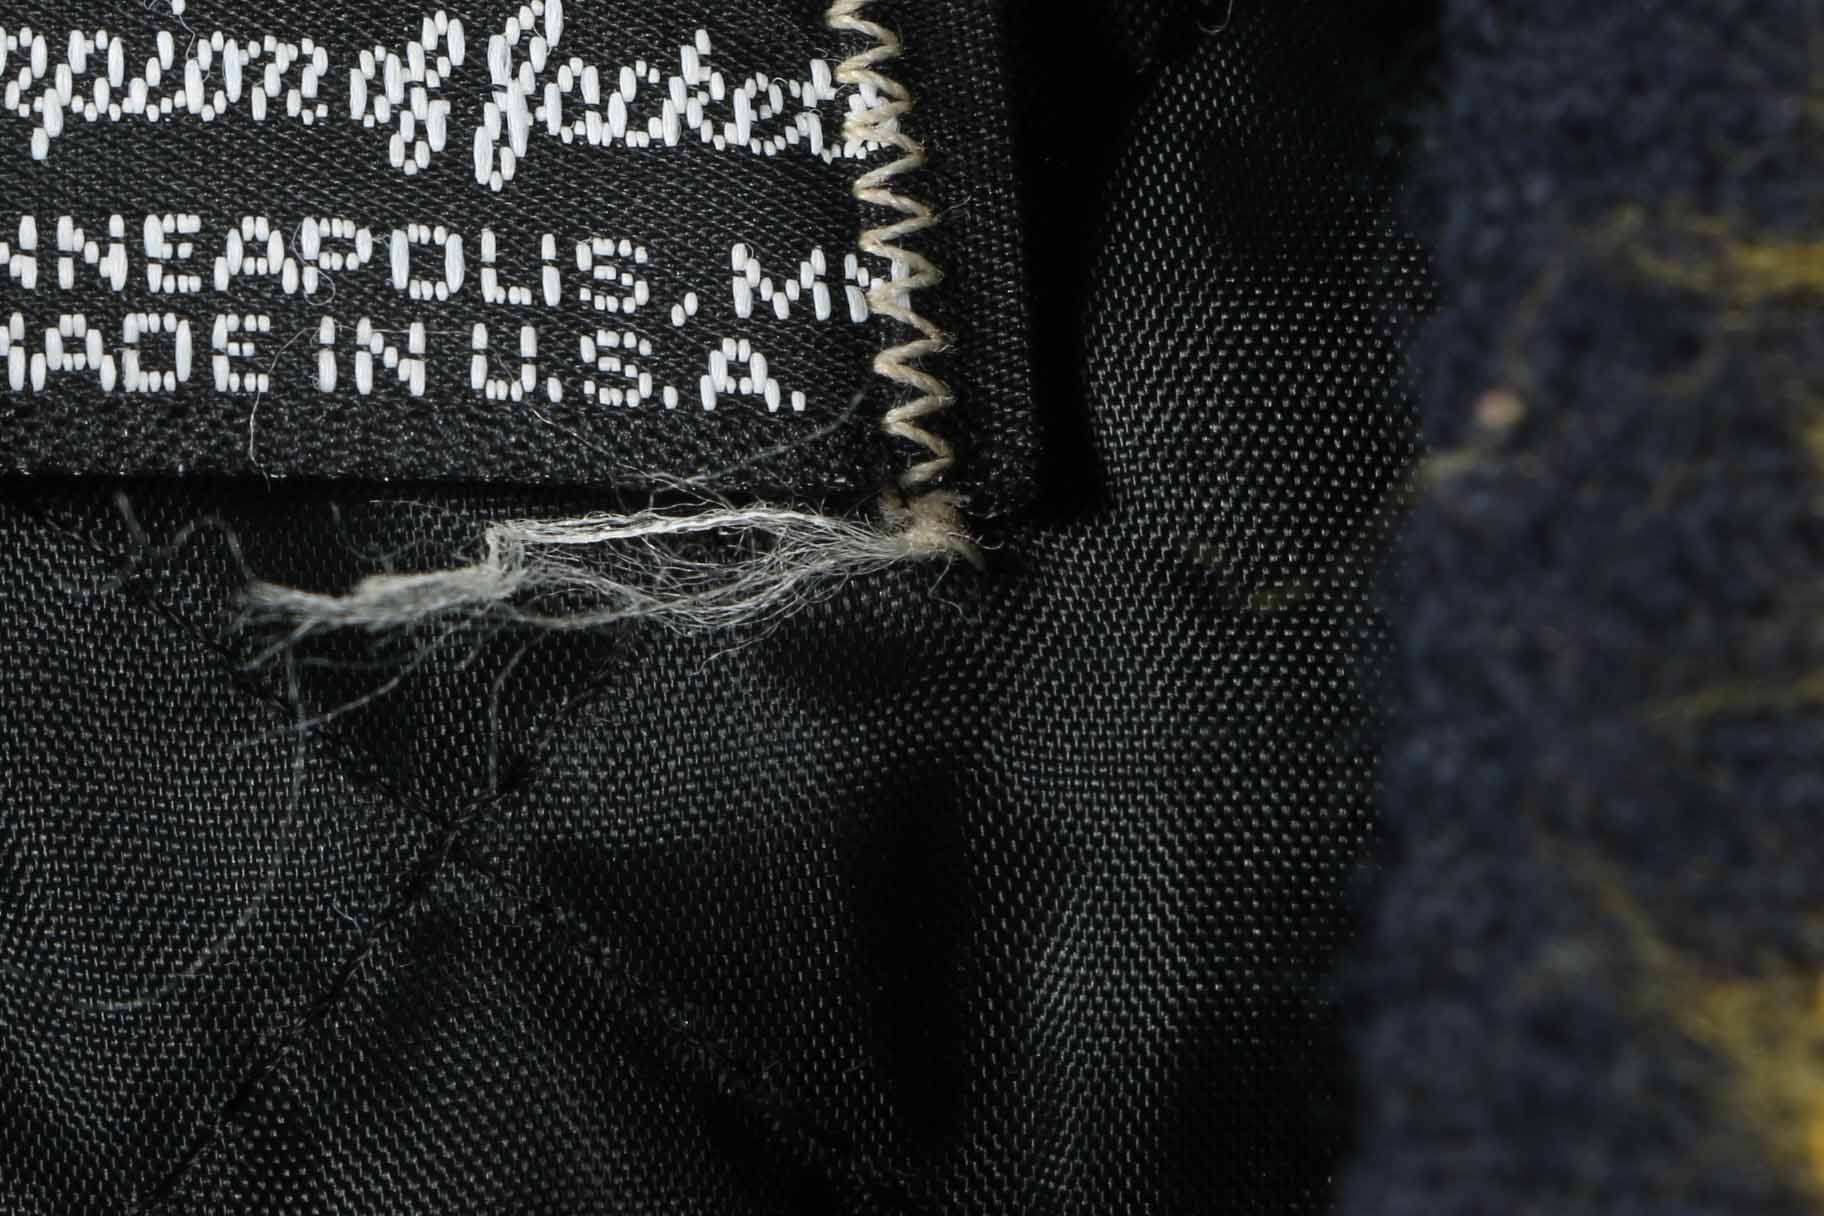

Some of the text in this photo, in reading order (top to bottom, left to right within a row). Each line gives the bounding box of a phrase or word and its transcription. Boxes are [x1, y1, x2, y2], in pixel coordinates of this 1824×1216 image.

[350, 8, 466, 176] of
[317, 314, 426, 397] IN
[470, 322, 806, 412] U.S.A.
